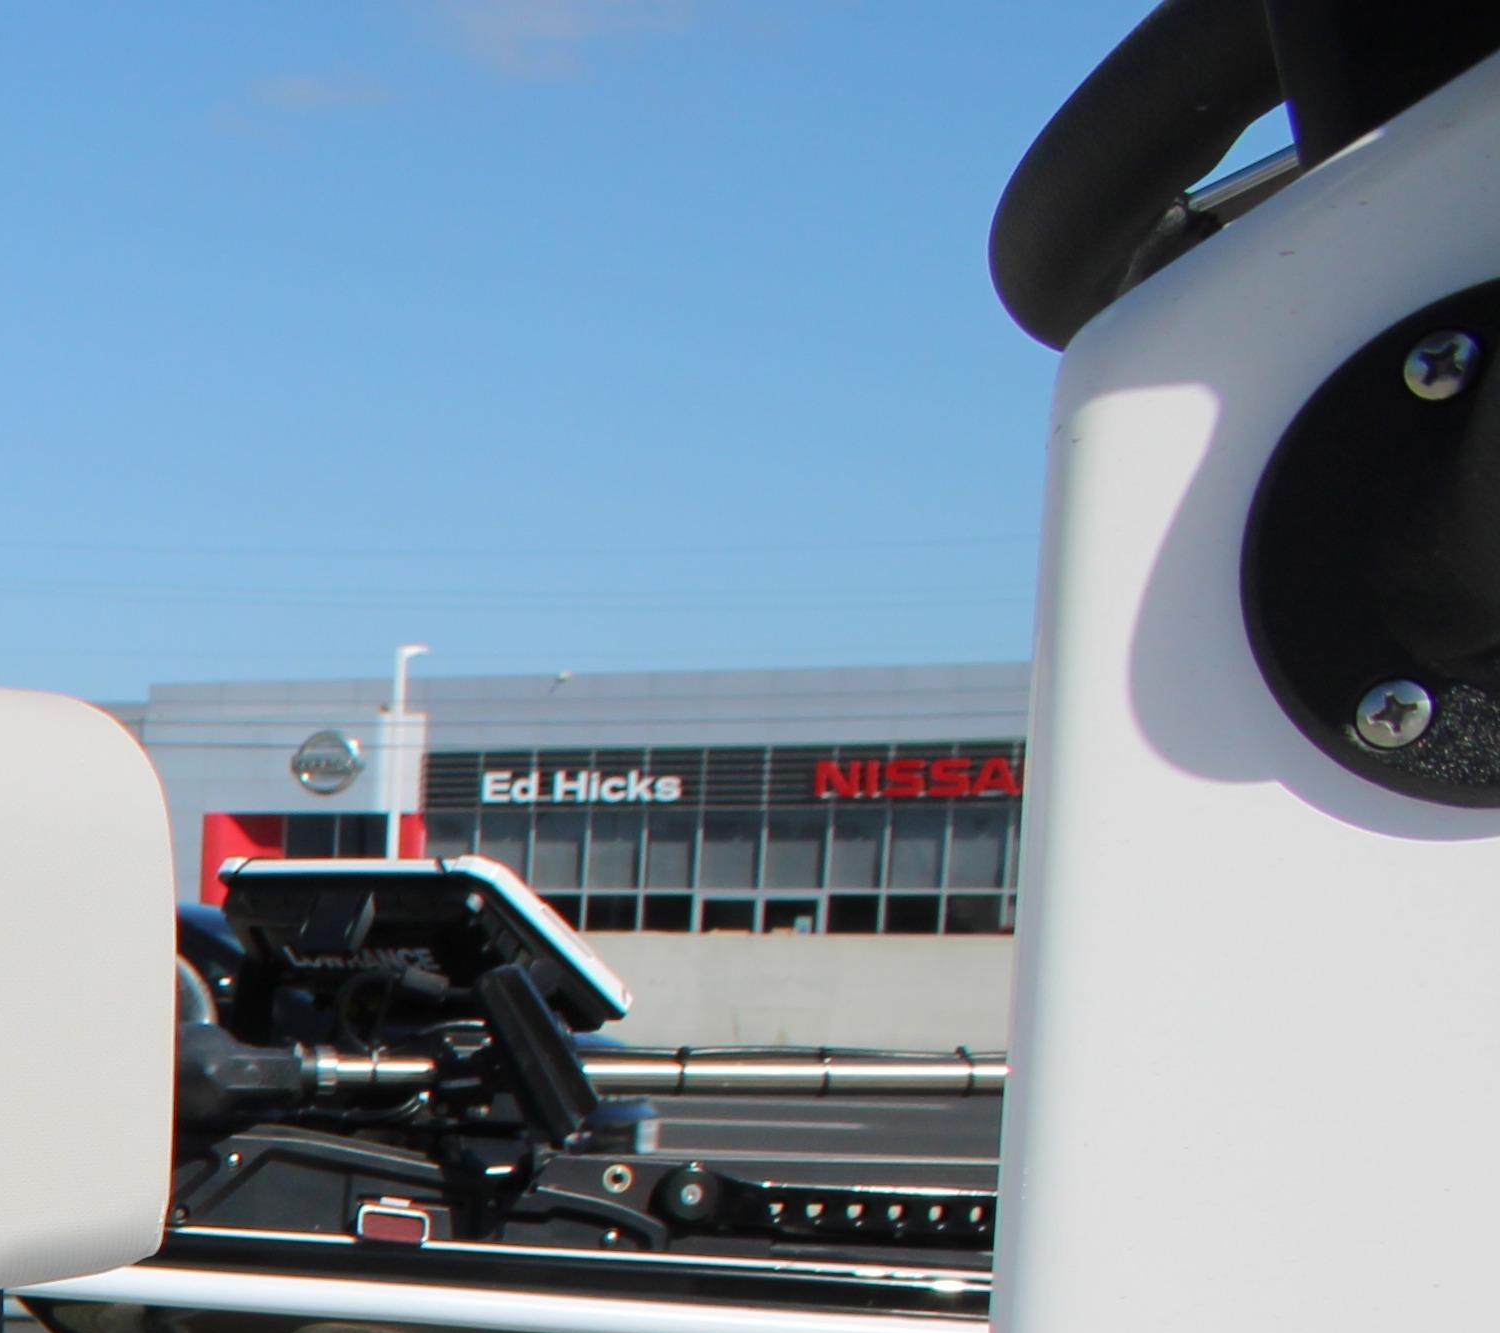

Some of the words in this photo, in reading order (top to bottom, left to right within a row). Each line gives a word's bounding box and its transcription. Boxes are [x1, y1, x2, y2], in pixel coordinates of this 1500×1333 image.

[481, 769, 541, 803] Ed
[552, 768, 683, 802] Hicks
[814, 756, 1026, 799] NISSA
